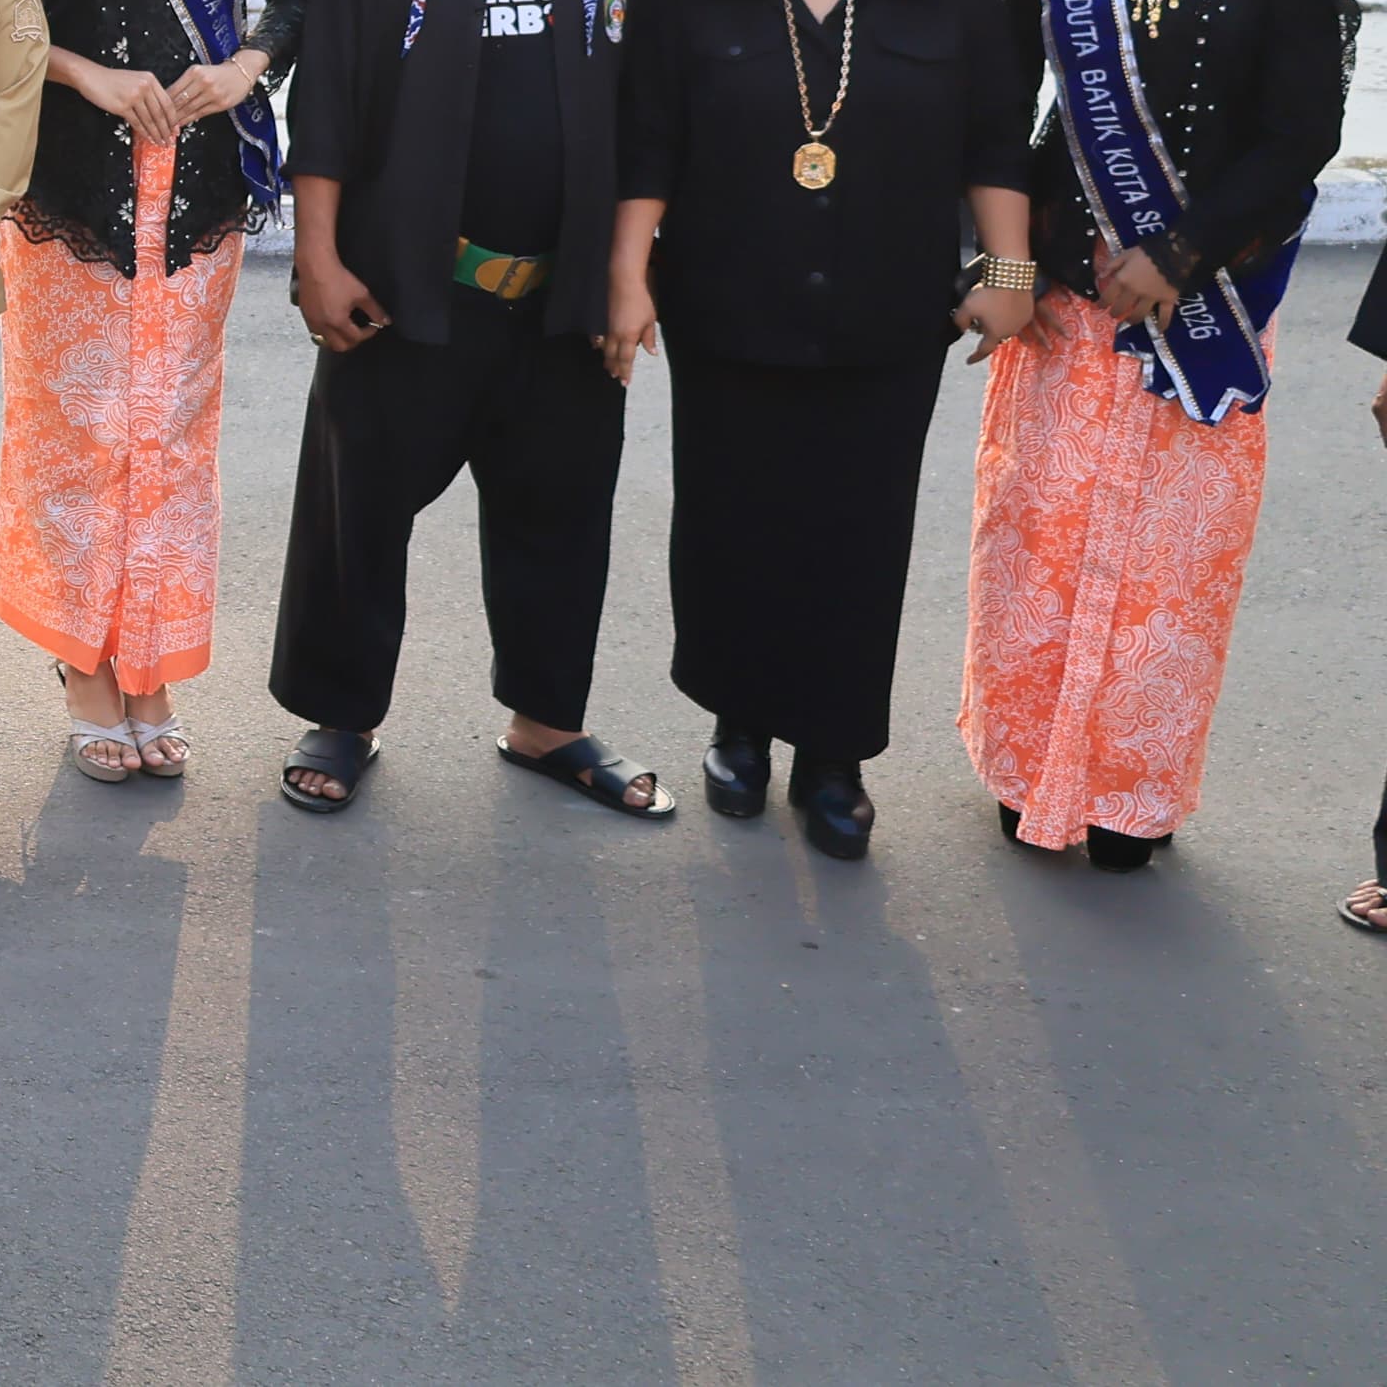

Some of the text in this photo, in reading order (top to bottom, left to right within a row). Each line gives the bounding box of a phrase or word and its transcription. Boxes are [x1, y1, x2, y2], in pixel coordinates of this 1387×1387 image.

[1080, 69, 1126, 141] BATIK
[1103, 147, 1151, 204] KOTA
[1179, 292, 1221, 339] 2026
